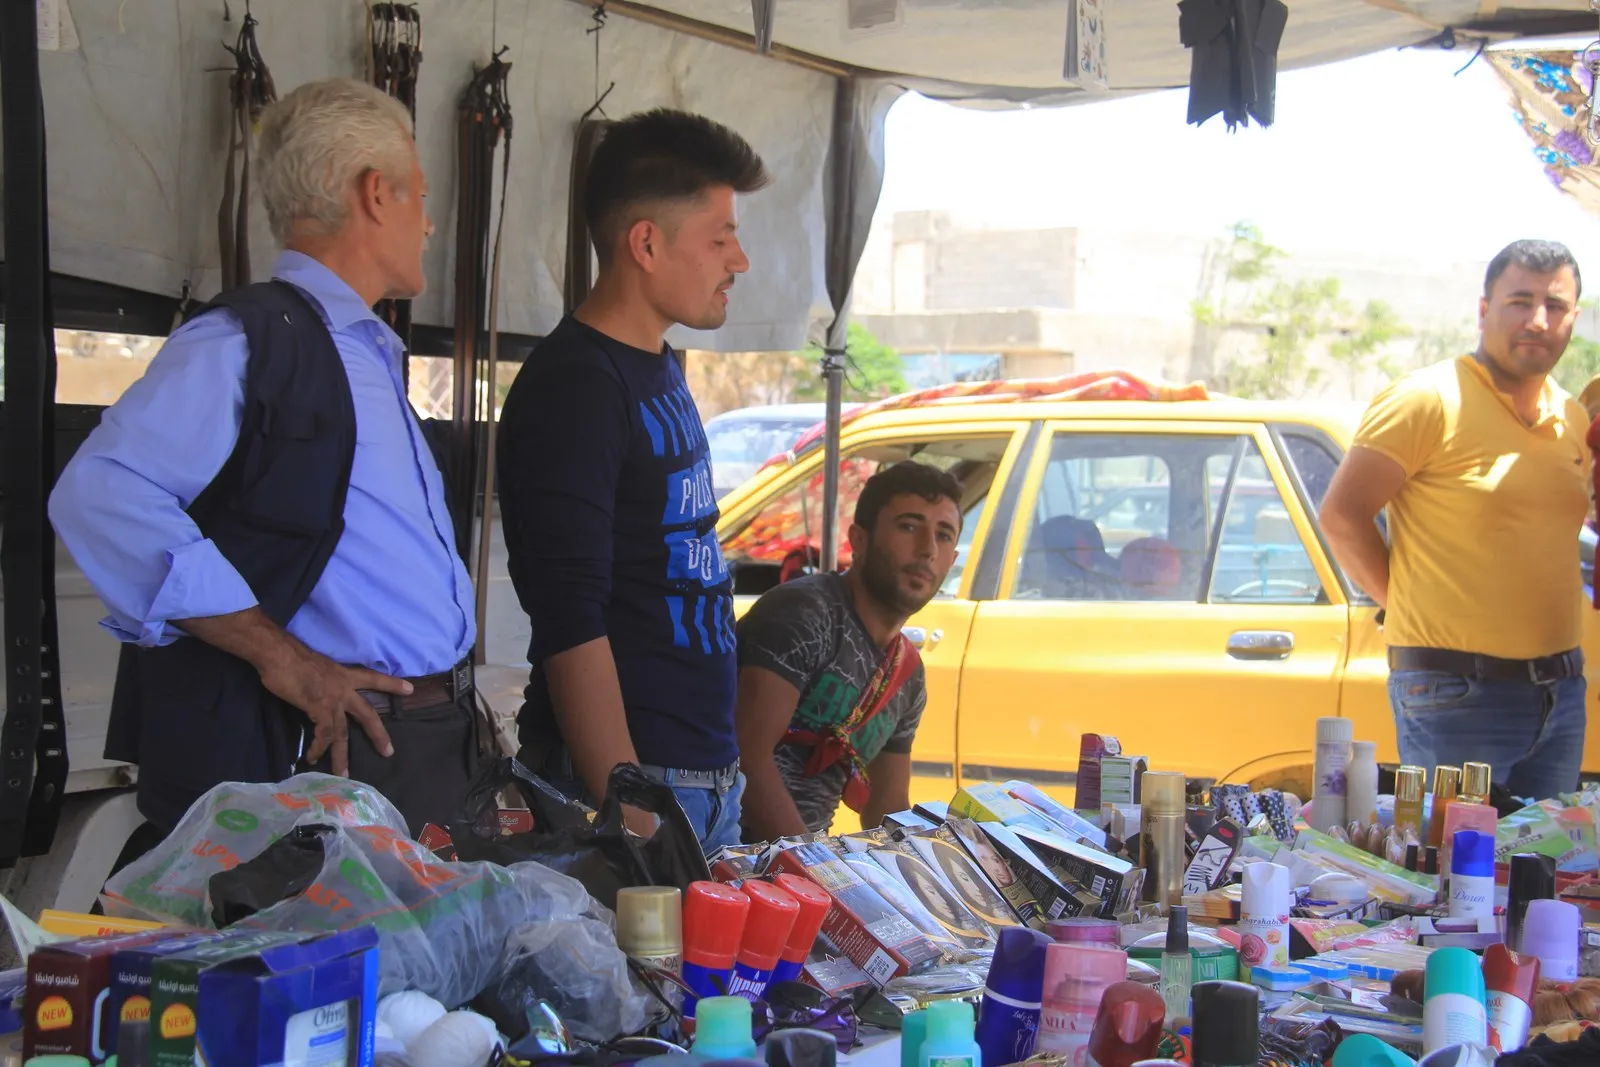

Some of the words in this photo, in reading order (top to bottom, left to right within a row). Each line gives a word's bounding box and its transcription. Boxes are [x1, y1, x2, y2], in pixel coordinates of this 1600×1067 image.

[42, 1006, 69, 1022] NEW
[125, 1006, 151, 1021] NEW
[165, 1014, 192, 1030] NEW
